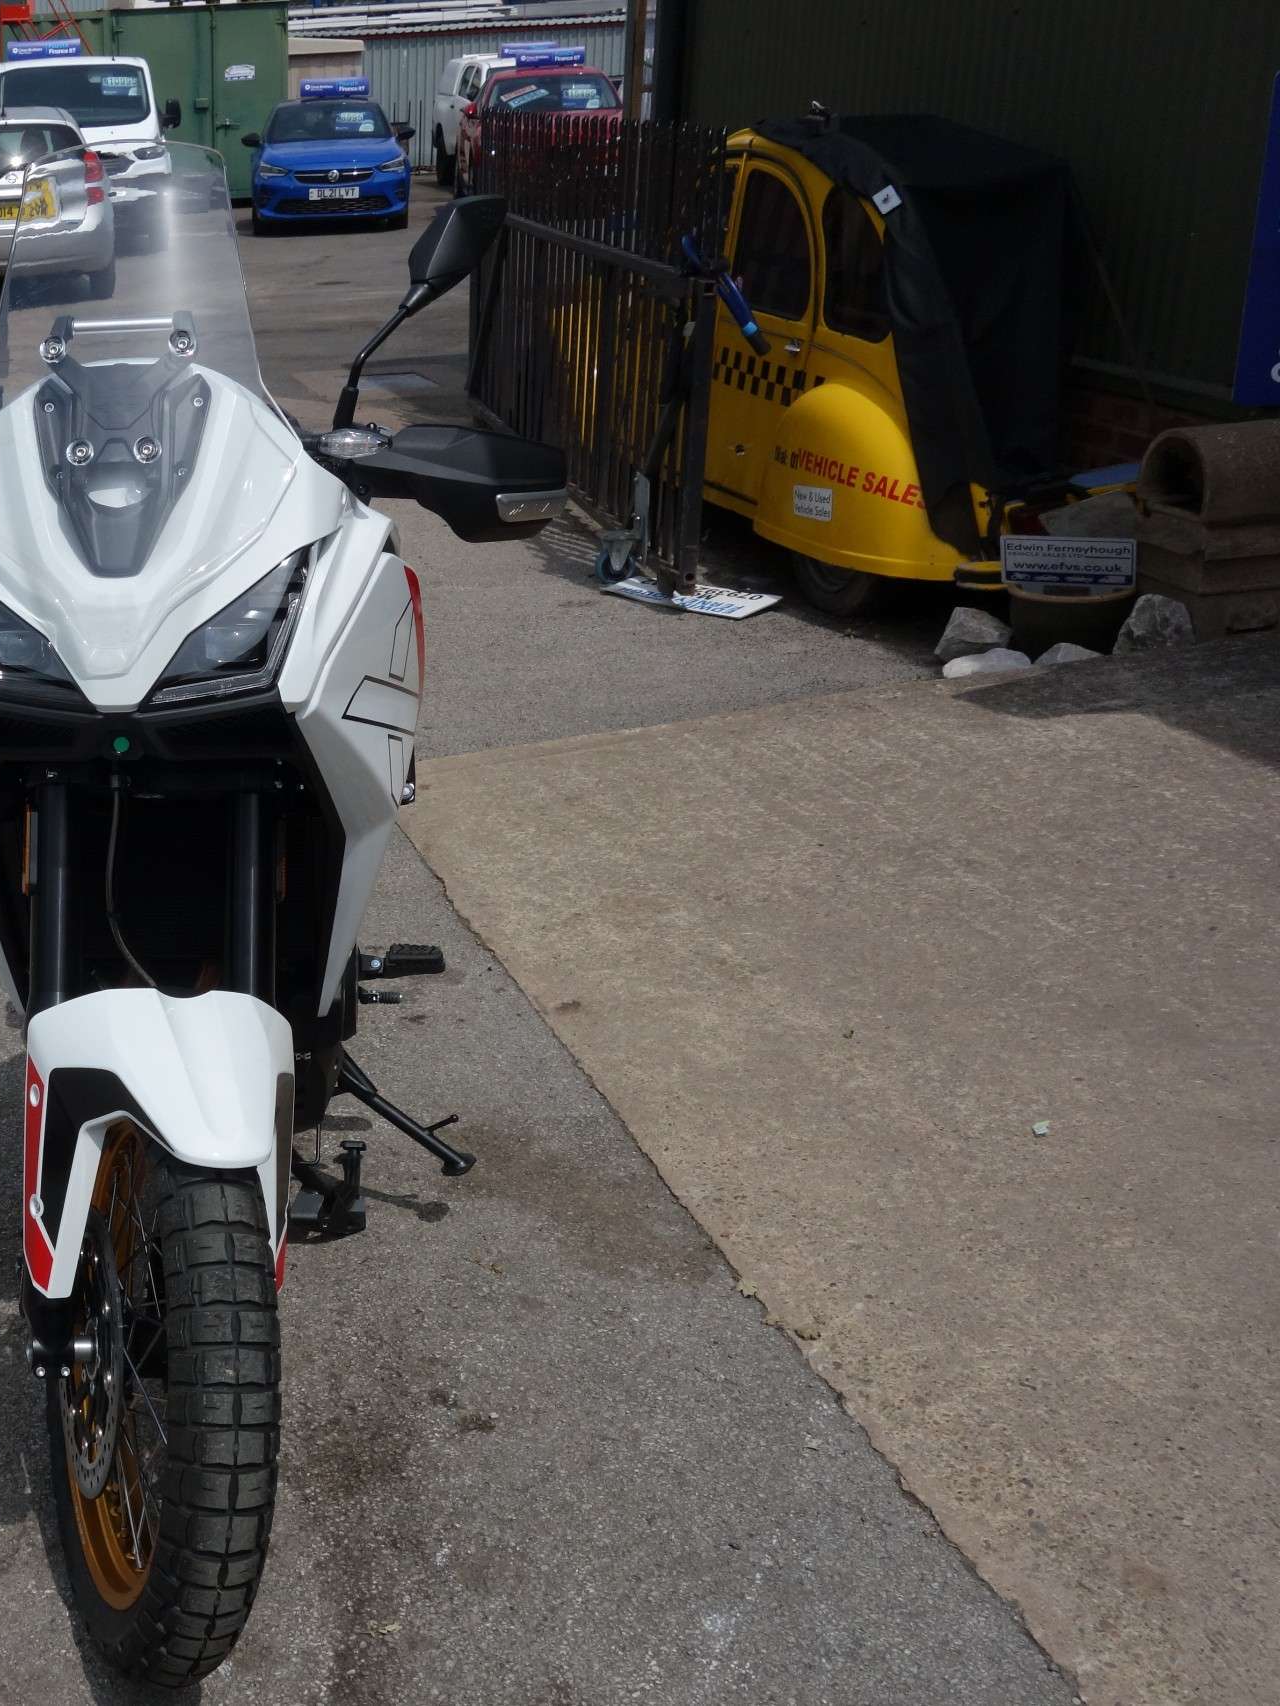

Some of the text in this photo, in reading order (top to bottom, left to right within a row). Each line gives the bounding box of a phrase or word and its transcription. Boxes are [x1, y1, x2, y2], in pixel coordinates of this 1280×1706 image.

[799, 449, 860, 488] VEHICLE
[814, 491, 831, 504] Used
[1007, 543, 1044, 552] Edwin
